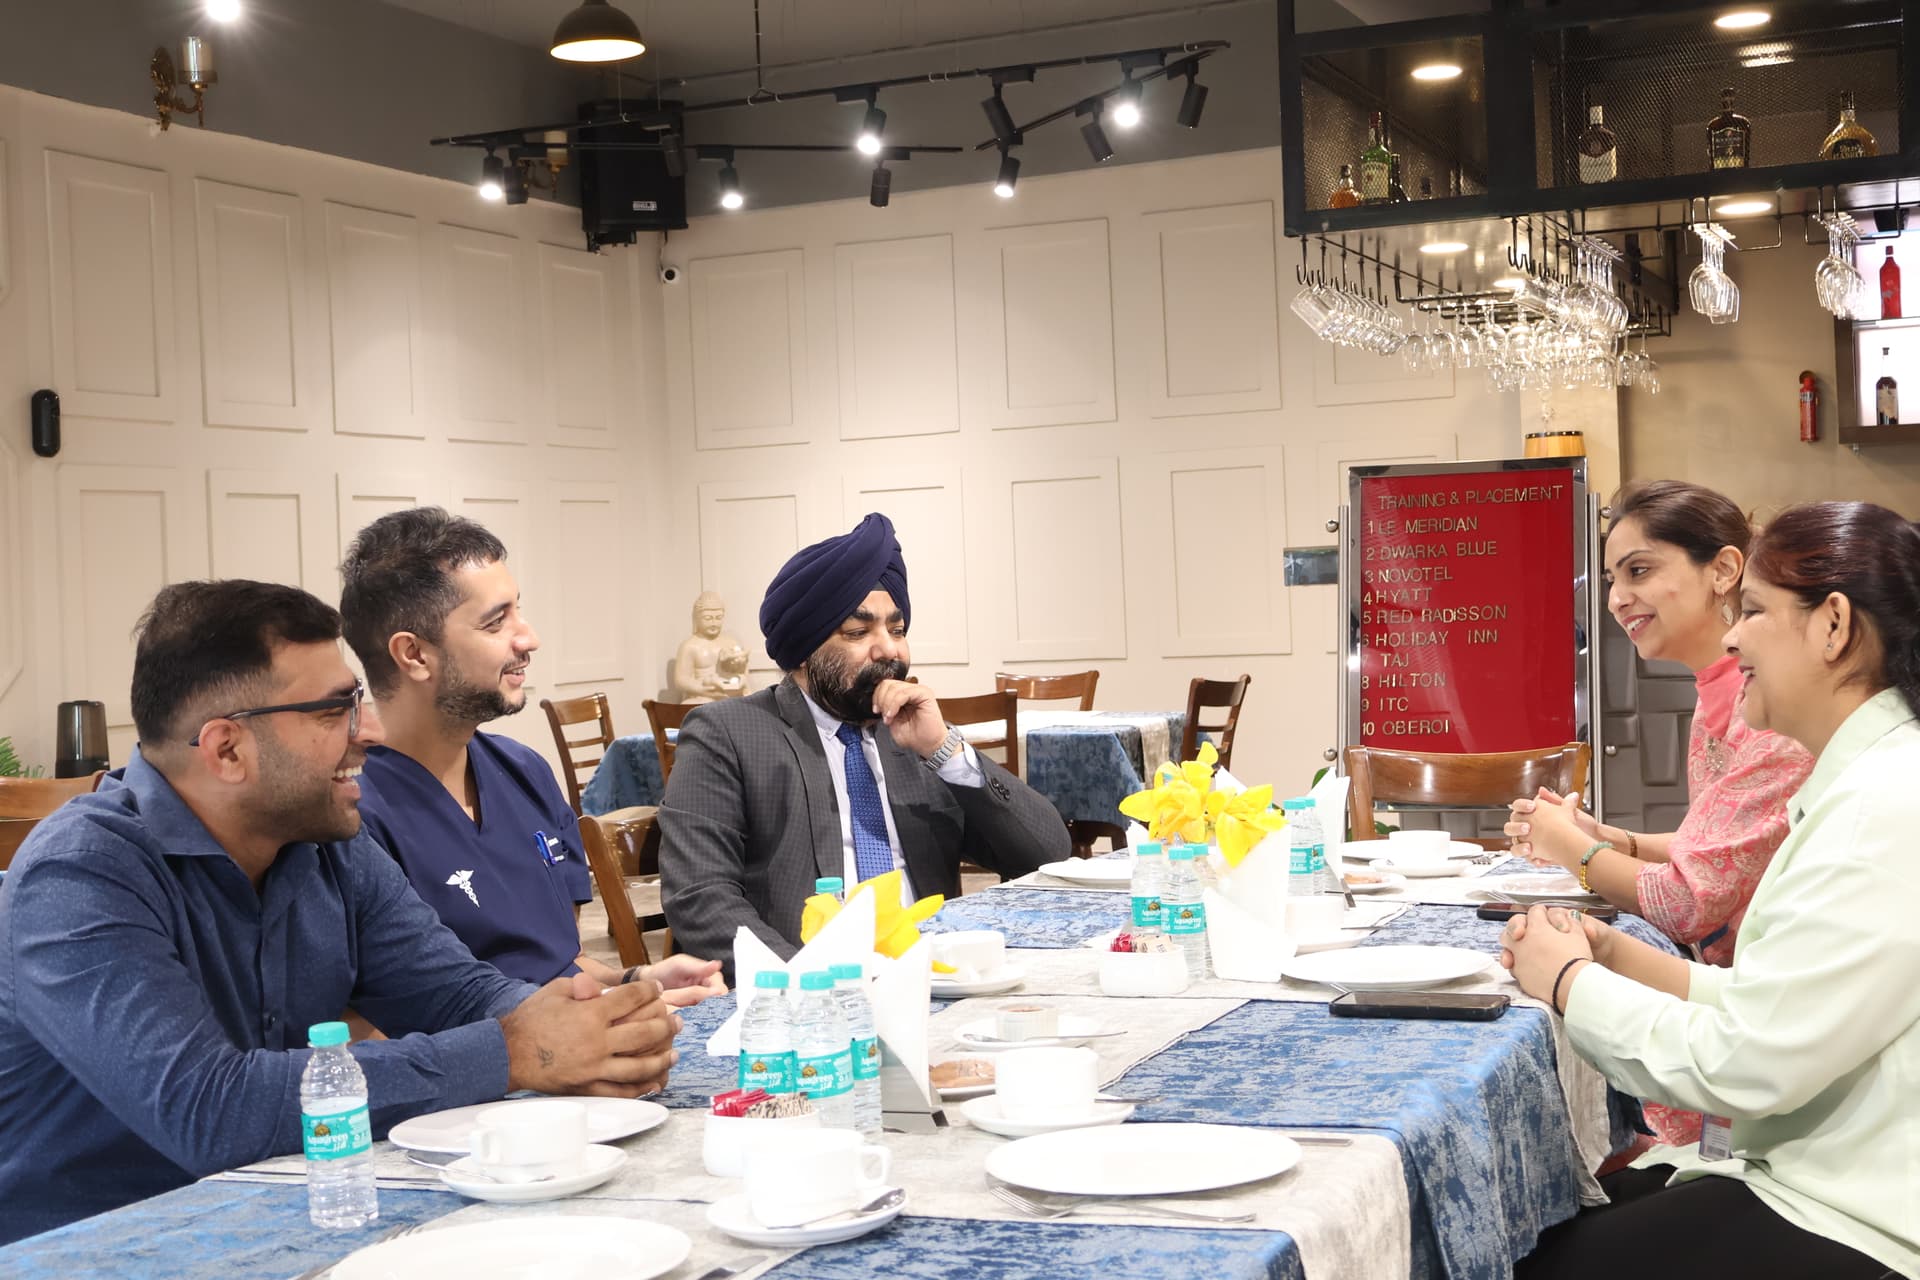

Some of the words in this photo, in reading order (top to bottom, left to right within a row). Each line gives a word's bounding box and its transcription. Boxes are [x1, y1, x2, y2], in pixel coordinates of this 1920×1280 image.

[1378, 492, 1446, 510] TRAINING
[1450, 490, 1460, 505] &
[1465, 484, 1563, 505] PLACEMENT
[1367, 519, 1374, 535] 1
[1378, 520, 1396, 535] LE
[1405, 516, 1478, 534] MERIDIAN
[1366, 546, 1375, 561] 2
[1380, 543, 1448, 561] DWARKA
[1456, 540, 1497, 557] BLUE
[1364, 569, 1374, 584] 3
[1378, 566, 1453, 583] NOVOTEL
[1363, 591, 1373, 606] 4
[1376, 587, 1433, 604] HYATT
[1363, 610, 1372, 625] 5
[1376, 609, 1414, 625] RED
[1421, 604, 1507, 624] RADISSON
[1375, 630, 1449, 648] HOLIDAY
[1467, 629, 1498, 645] INN
[1380, 652, 1409, 669] TAJ
[1361, 674, 1370, 690] 8
[1379, 671, 1447, 689] HILTON
[1361, 698, 1370, 712] 9
[1380, 696, 1409, 712] ITC
[1363, 721, 1375, 736] 10
[1382, 719, 1450, 735] OBEROI
